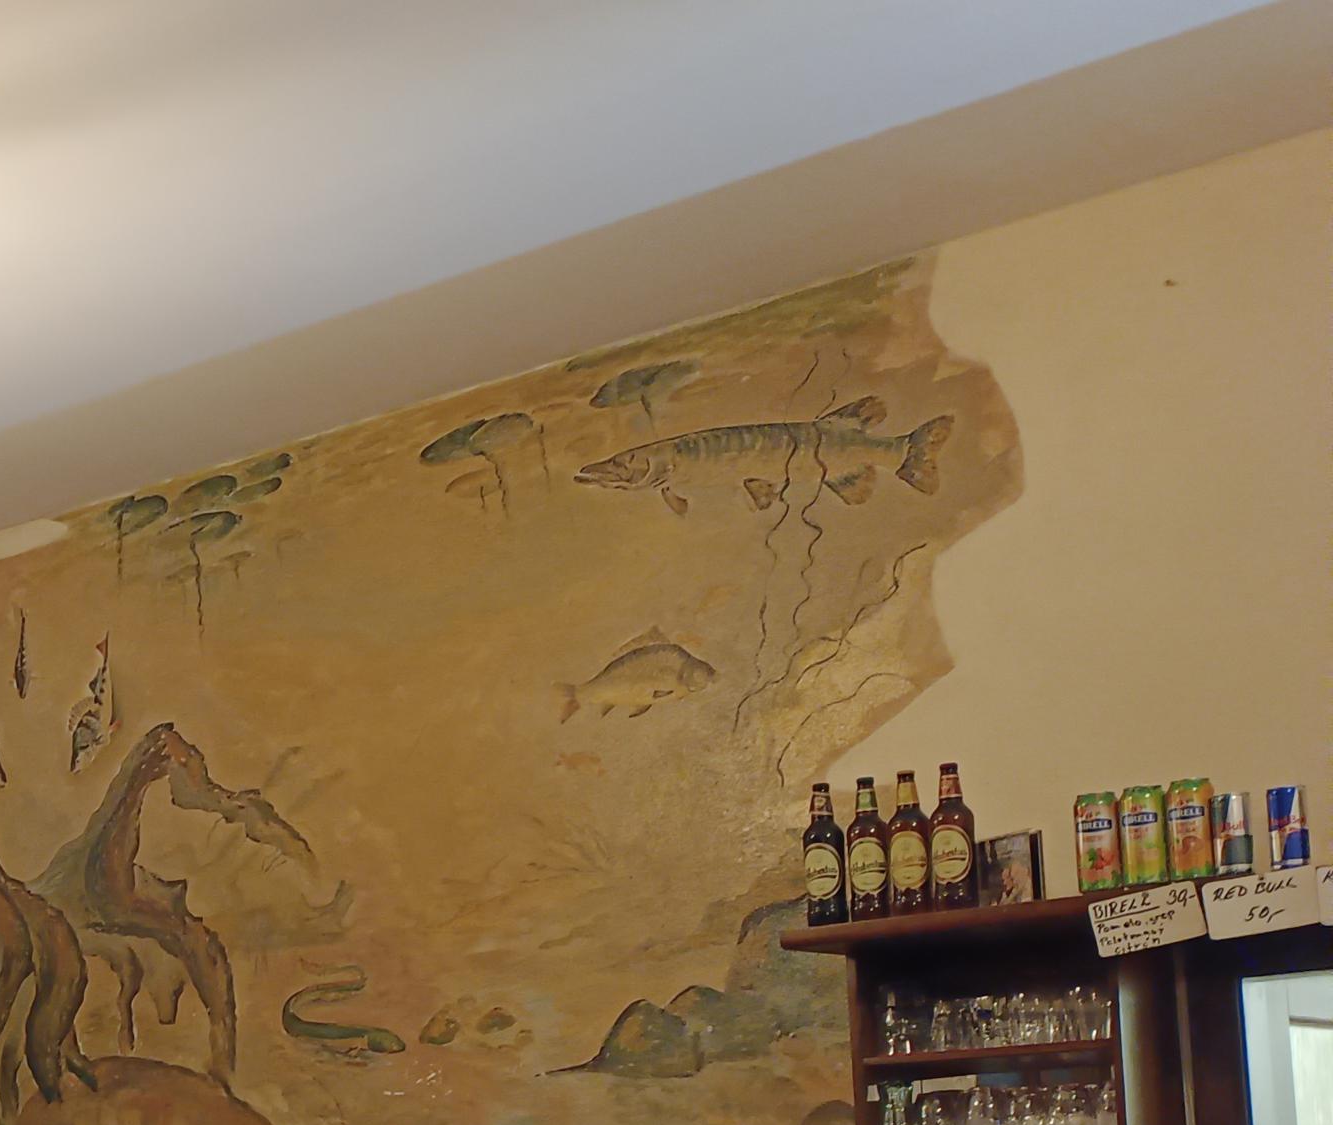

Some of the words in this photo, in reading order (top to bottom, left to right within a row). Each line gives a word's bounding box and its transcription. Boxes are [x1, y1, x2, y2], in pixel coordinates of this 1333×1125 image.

[1213, 886, 1248, 902] RED
[1254, 877, 1298, 894] BULL
[1093, 893, 1152, 919] BIRELL
